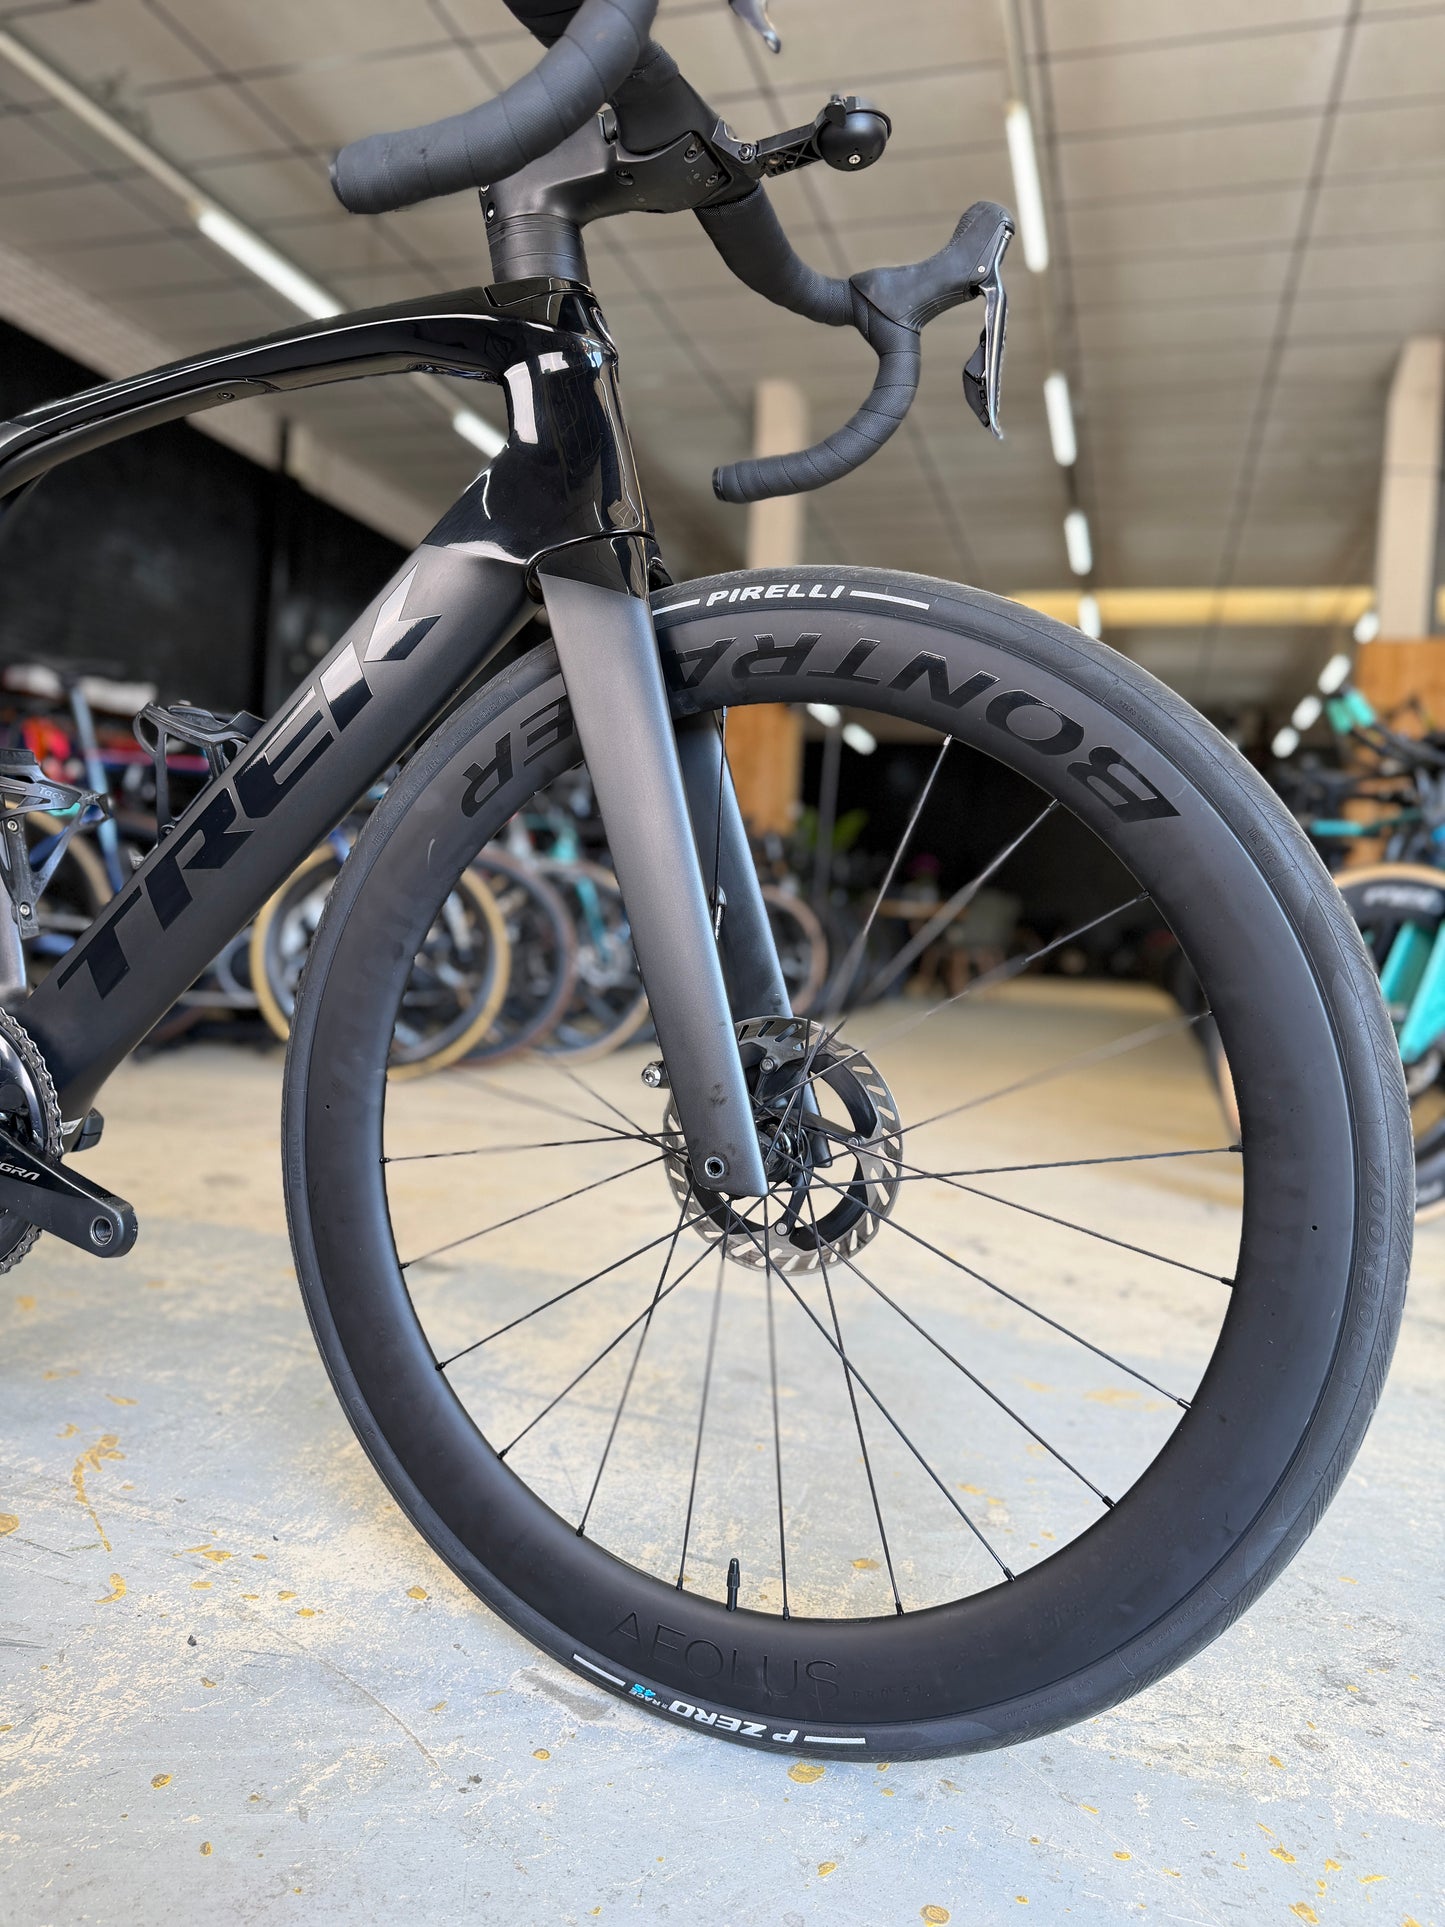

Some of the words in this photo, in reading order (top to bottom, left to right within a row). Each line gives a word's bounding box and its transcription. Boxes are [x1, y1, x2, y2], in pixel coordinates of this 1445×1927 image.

[707, 583, 844, 605] PIRELLI
[461, 631, 1181, 824] BONTRAER
[39, 786, 66, 803] Tacx
[57, 562, 442, 999] TREK
[0, 1161, 41, 1182] GRA
[607, 1611, 840, 1701] AEOLUS
[669, 1700, 767, 1738] ZERO
[771, 1729, 799, 1744] P
